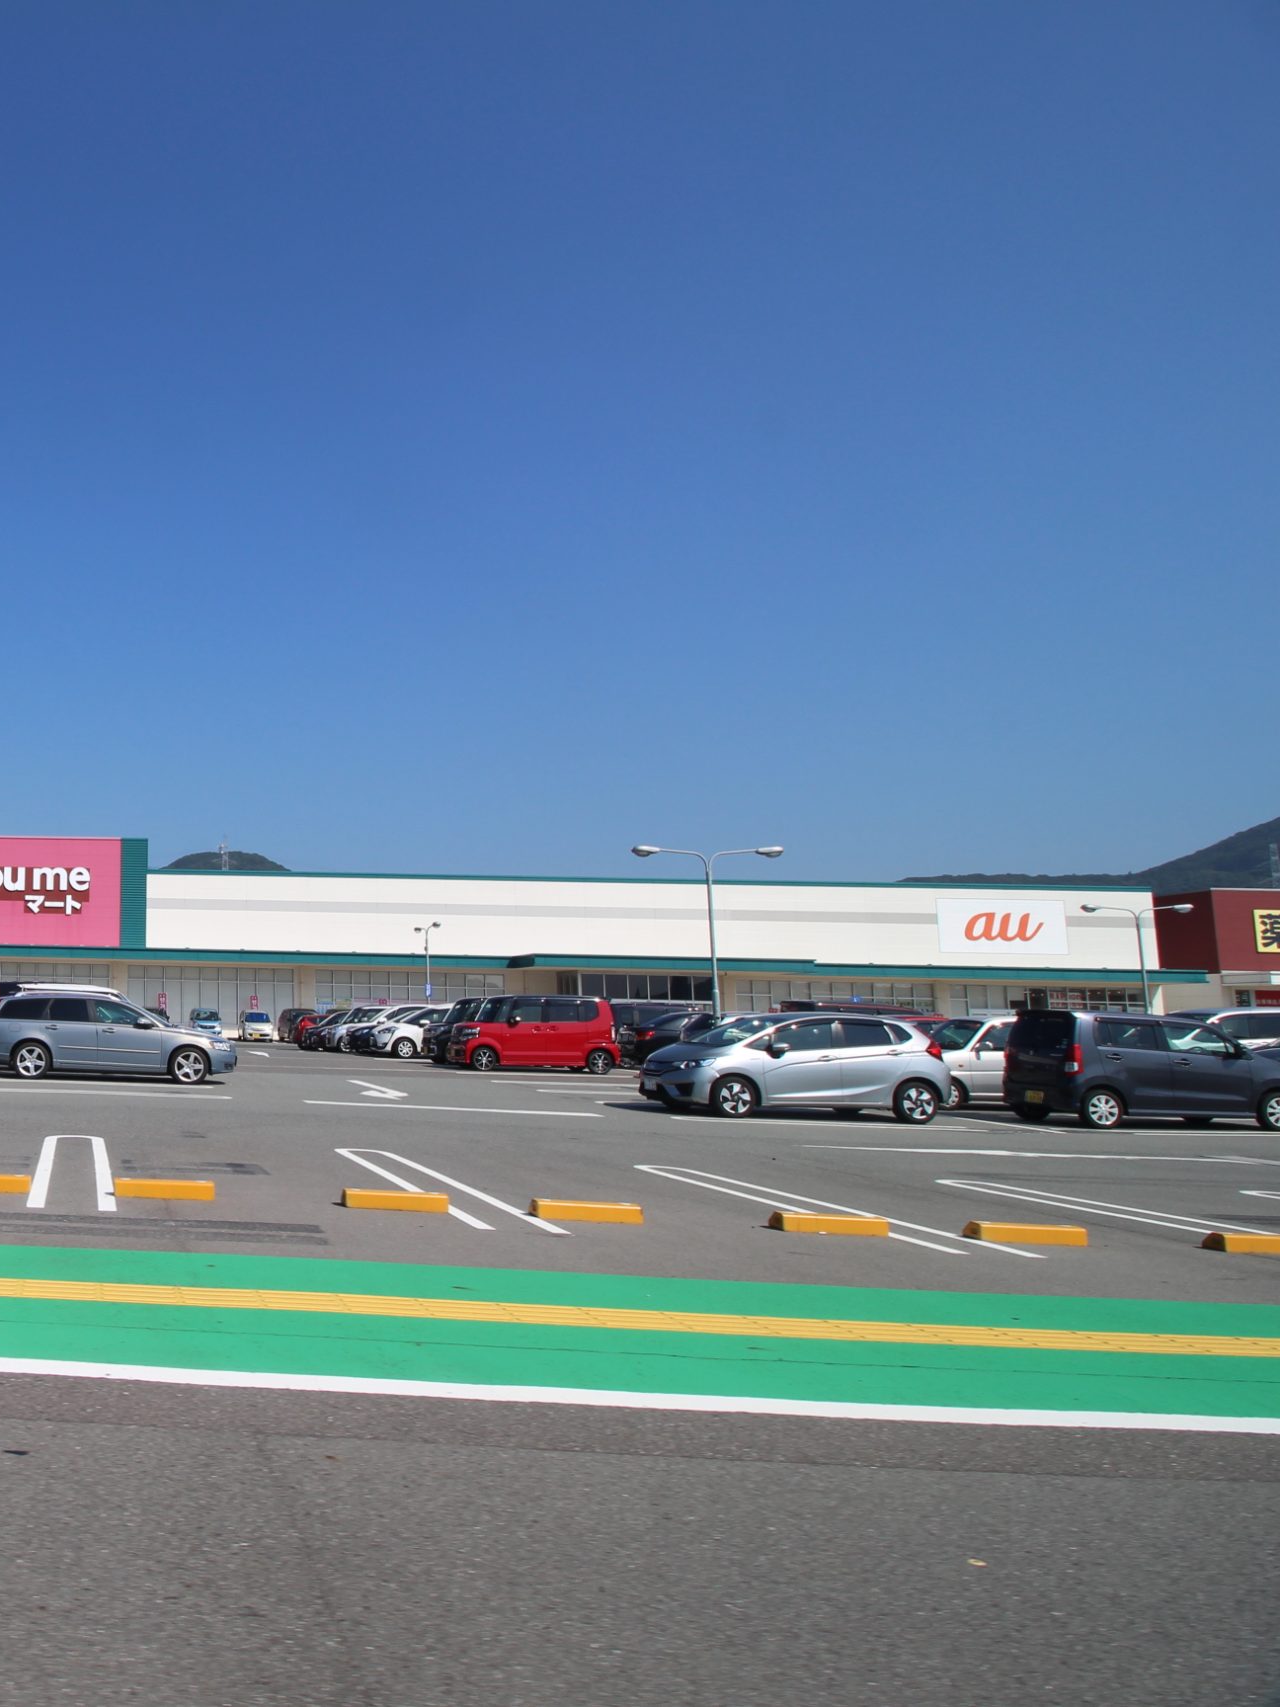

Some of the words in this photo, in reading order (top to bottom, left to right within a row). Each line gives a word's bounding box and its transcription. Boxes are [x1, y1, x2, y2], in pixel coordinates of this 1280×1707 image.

[25, 895, 81, 914] マート
[964, 912, 1044, 942] au
